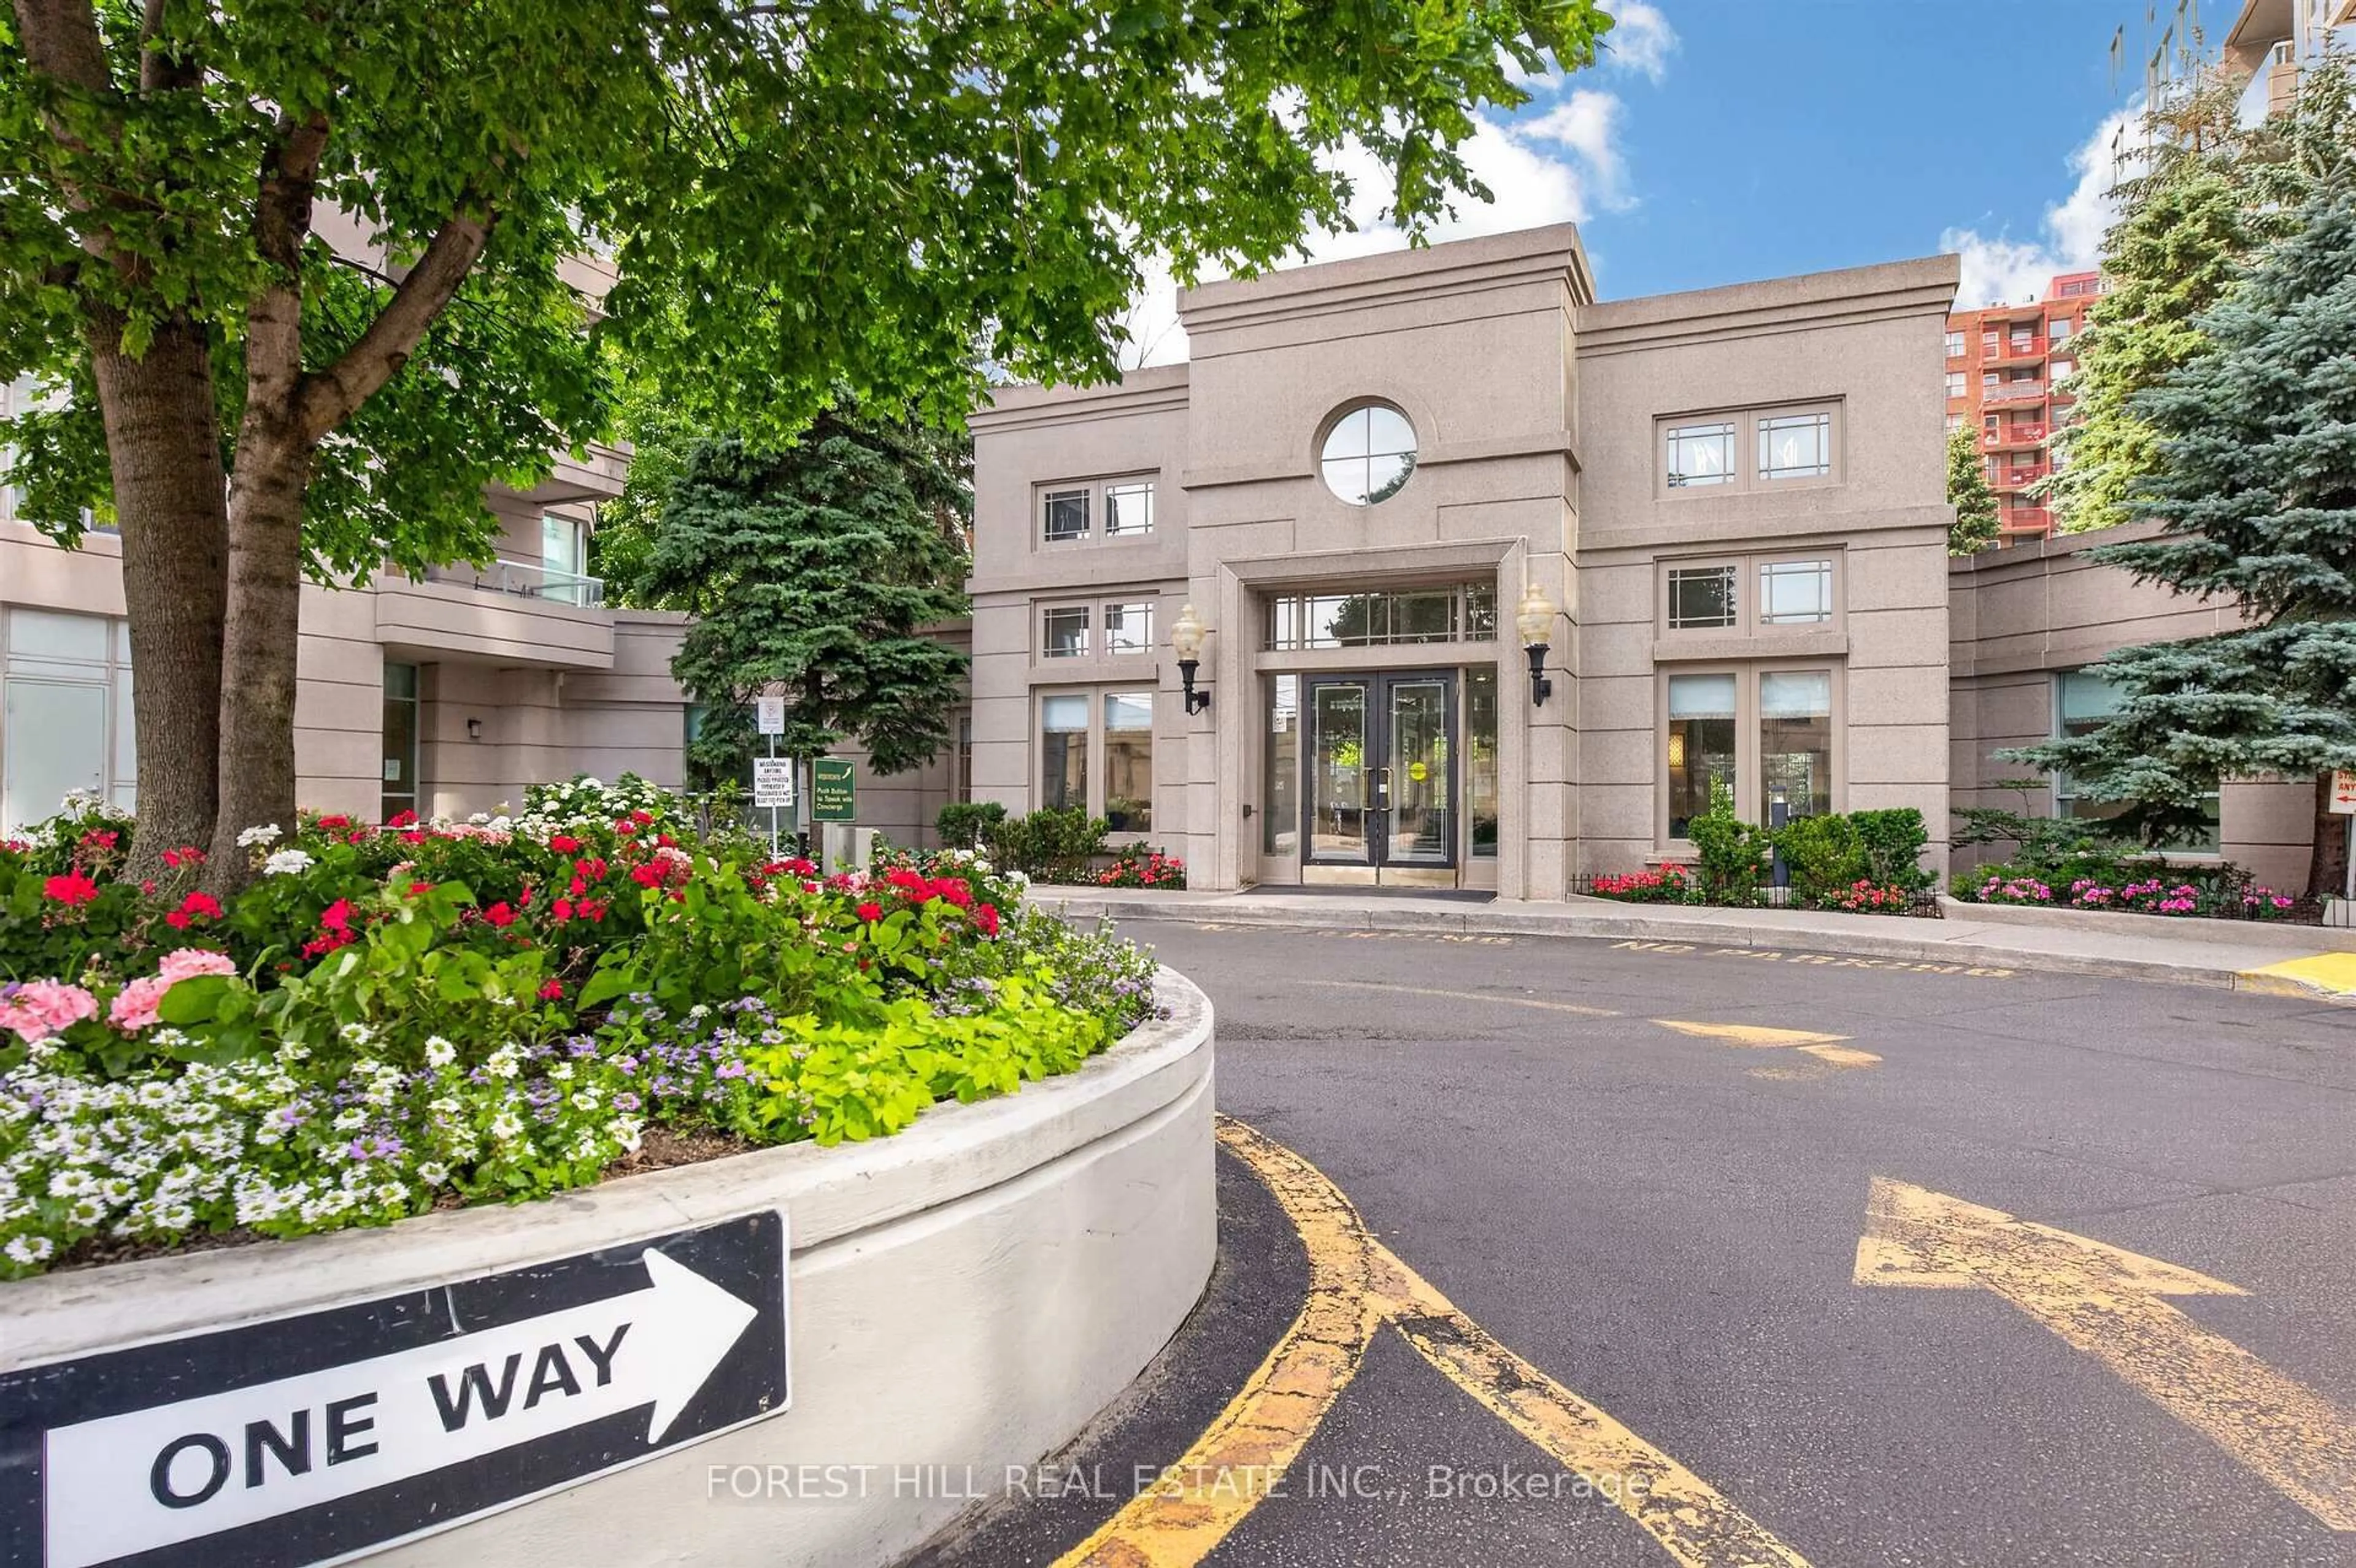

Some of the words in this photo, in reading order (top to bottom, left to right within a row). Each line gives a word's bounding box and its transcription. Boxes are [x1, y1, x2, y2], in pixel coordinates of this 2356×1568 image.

[1609, 941, 1697, 954] NO
[151, 1393, 379, 1509] ONE
[428, 1323, 632, 1432] WAY
